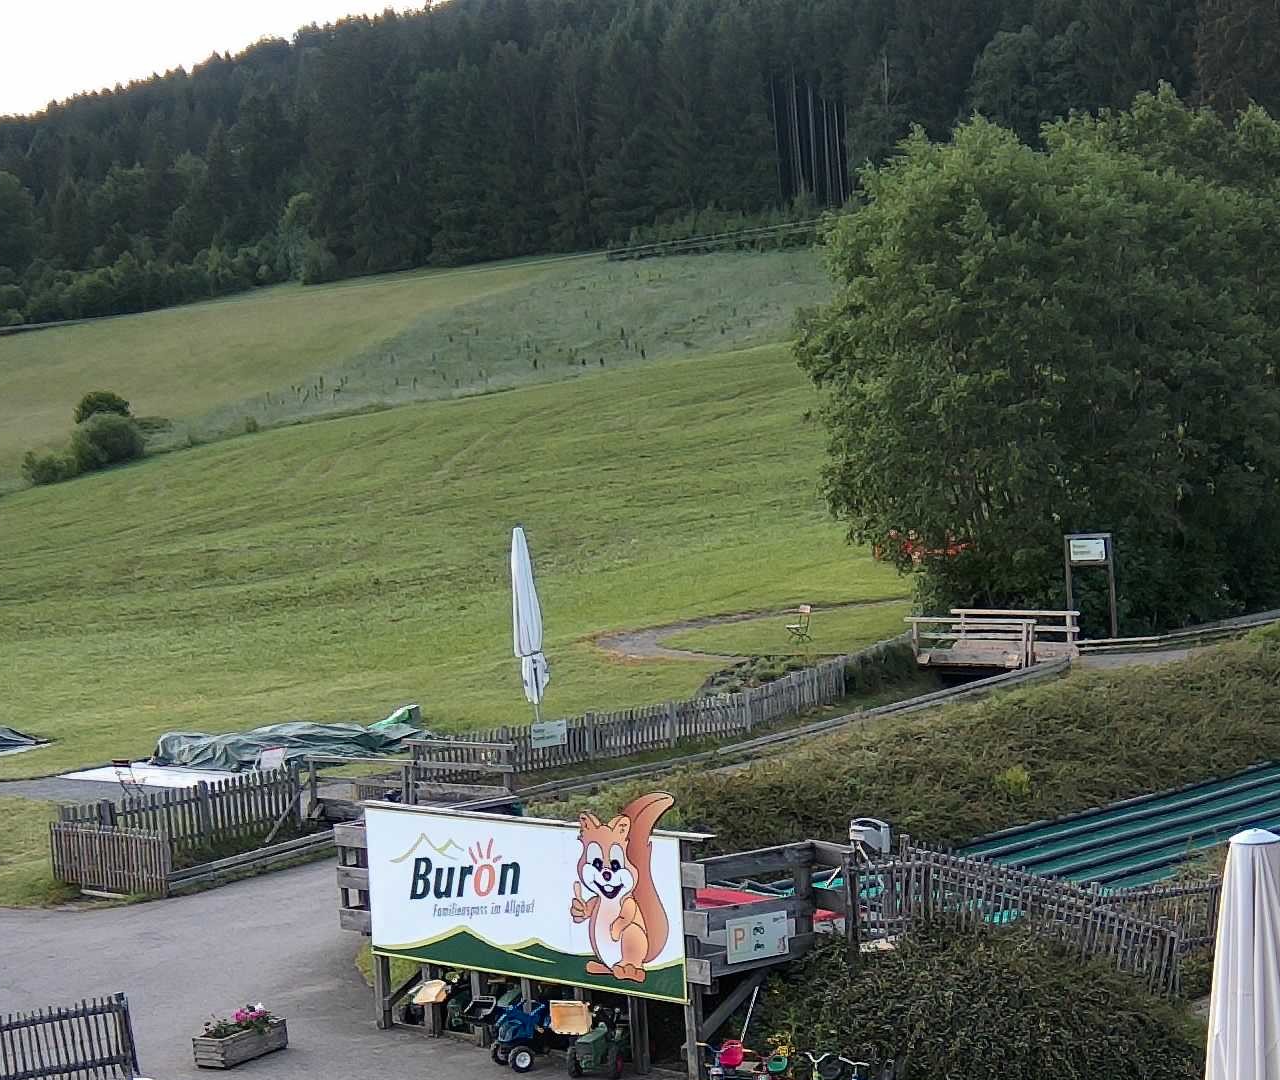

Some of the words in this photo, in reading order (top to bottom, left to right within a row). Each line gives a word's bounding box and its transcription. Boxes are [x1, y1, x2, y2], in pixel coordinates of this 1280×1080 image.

[410, 856, 521, 900] Buron
[433, 903, 488, 919] Familienspass
[491, 902, 501, 915] im
